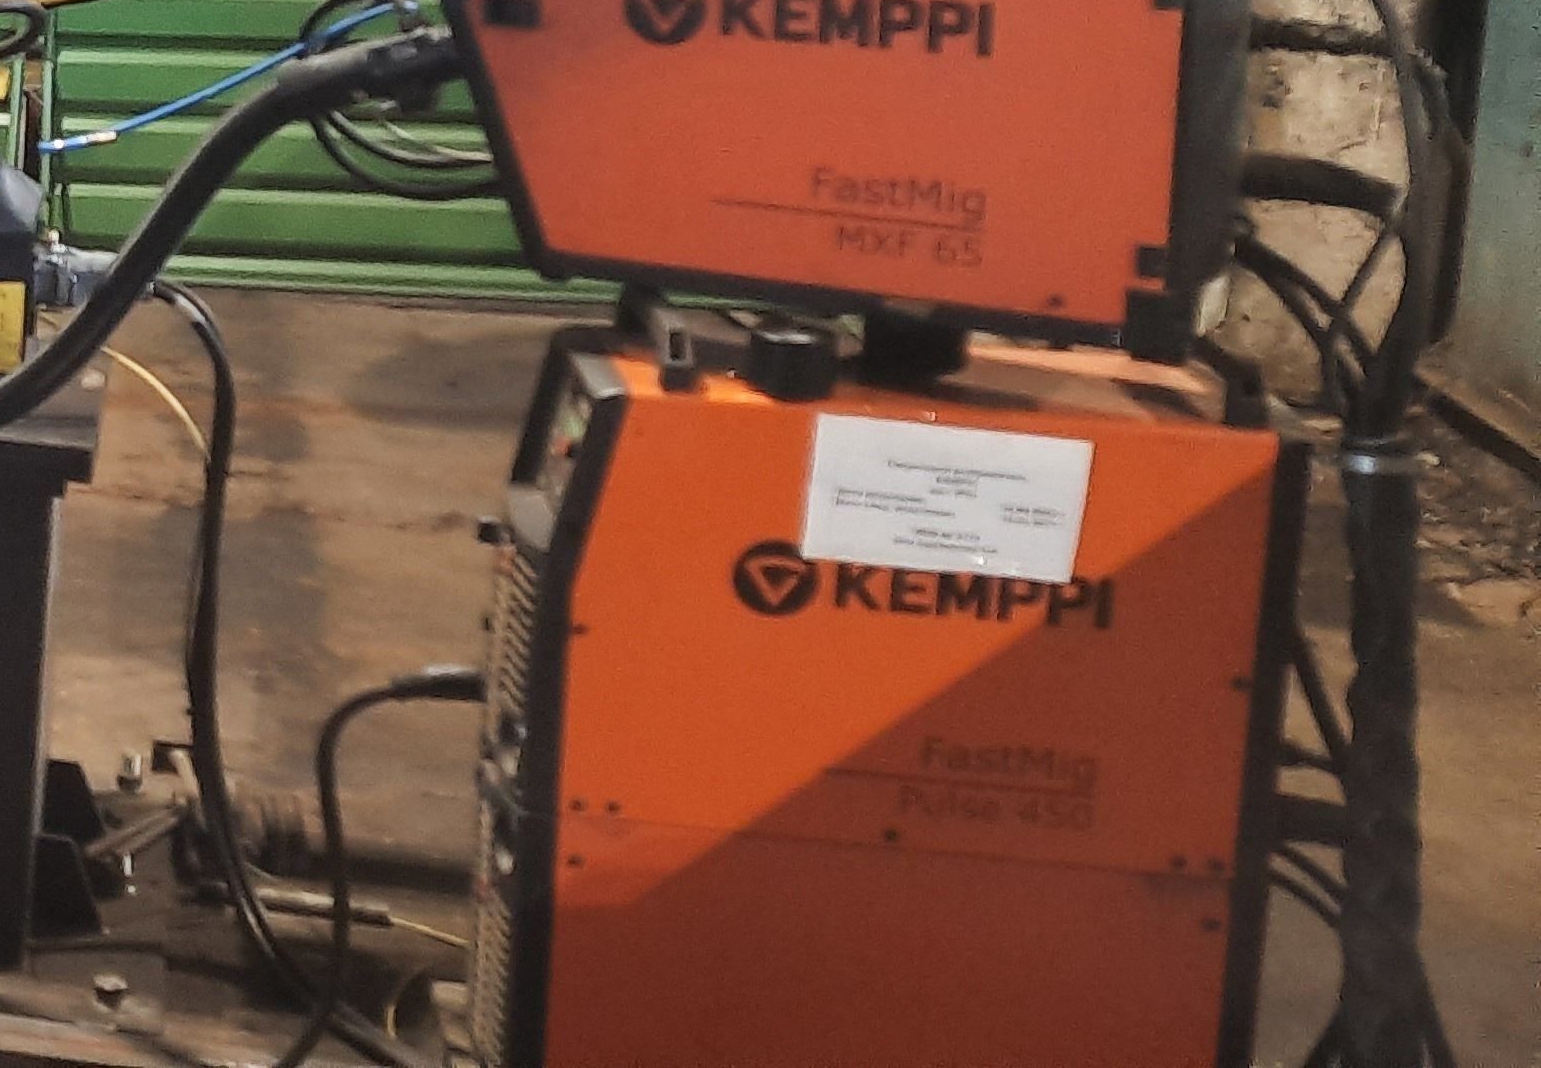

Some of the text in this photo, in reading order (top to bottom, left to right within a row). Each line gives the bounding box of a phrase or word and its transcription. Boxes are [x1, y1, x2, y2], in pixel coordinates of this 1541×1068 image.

[811, 166, 988, 223] FastMig
[836, 225, 984, 269] MXF 65
[835, 562, 1113, 630] KEMPPI
[921, 735, 1099, 799] FastMig
